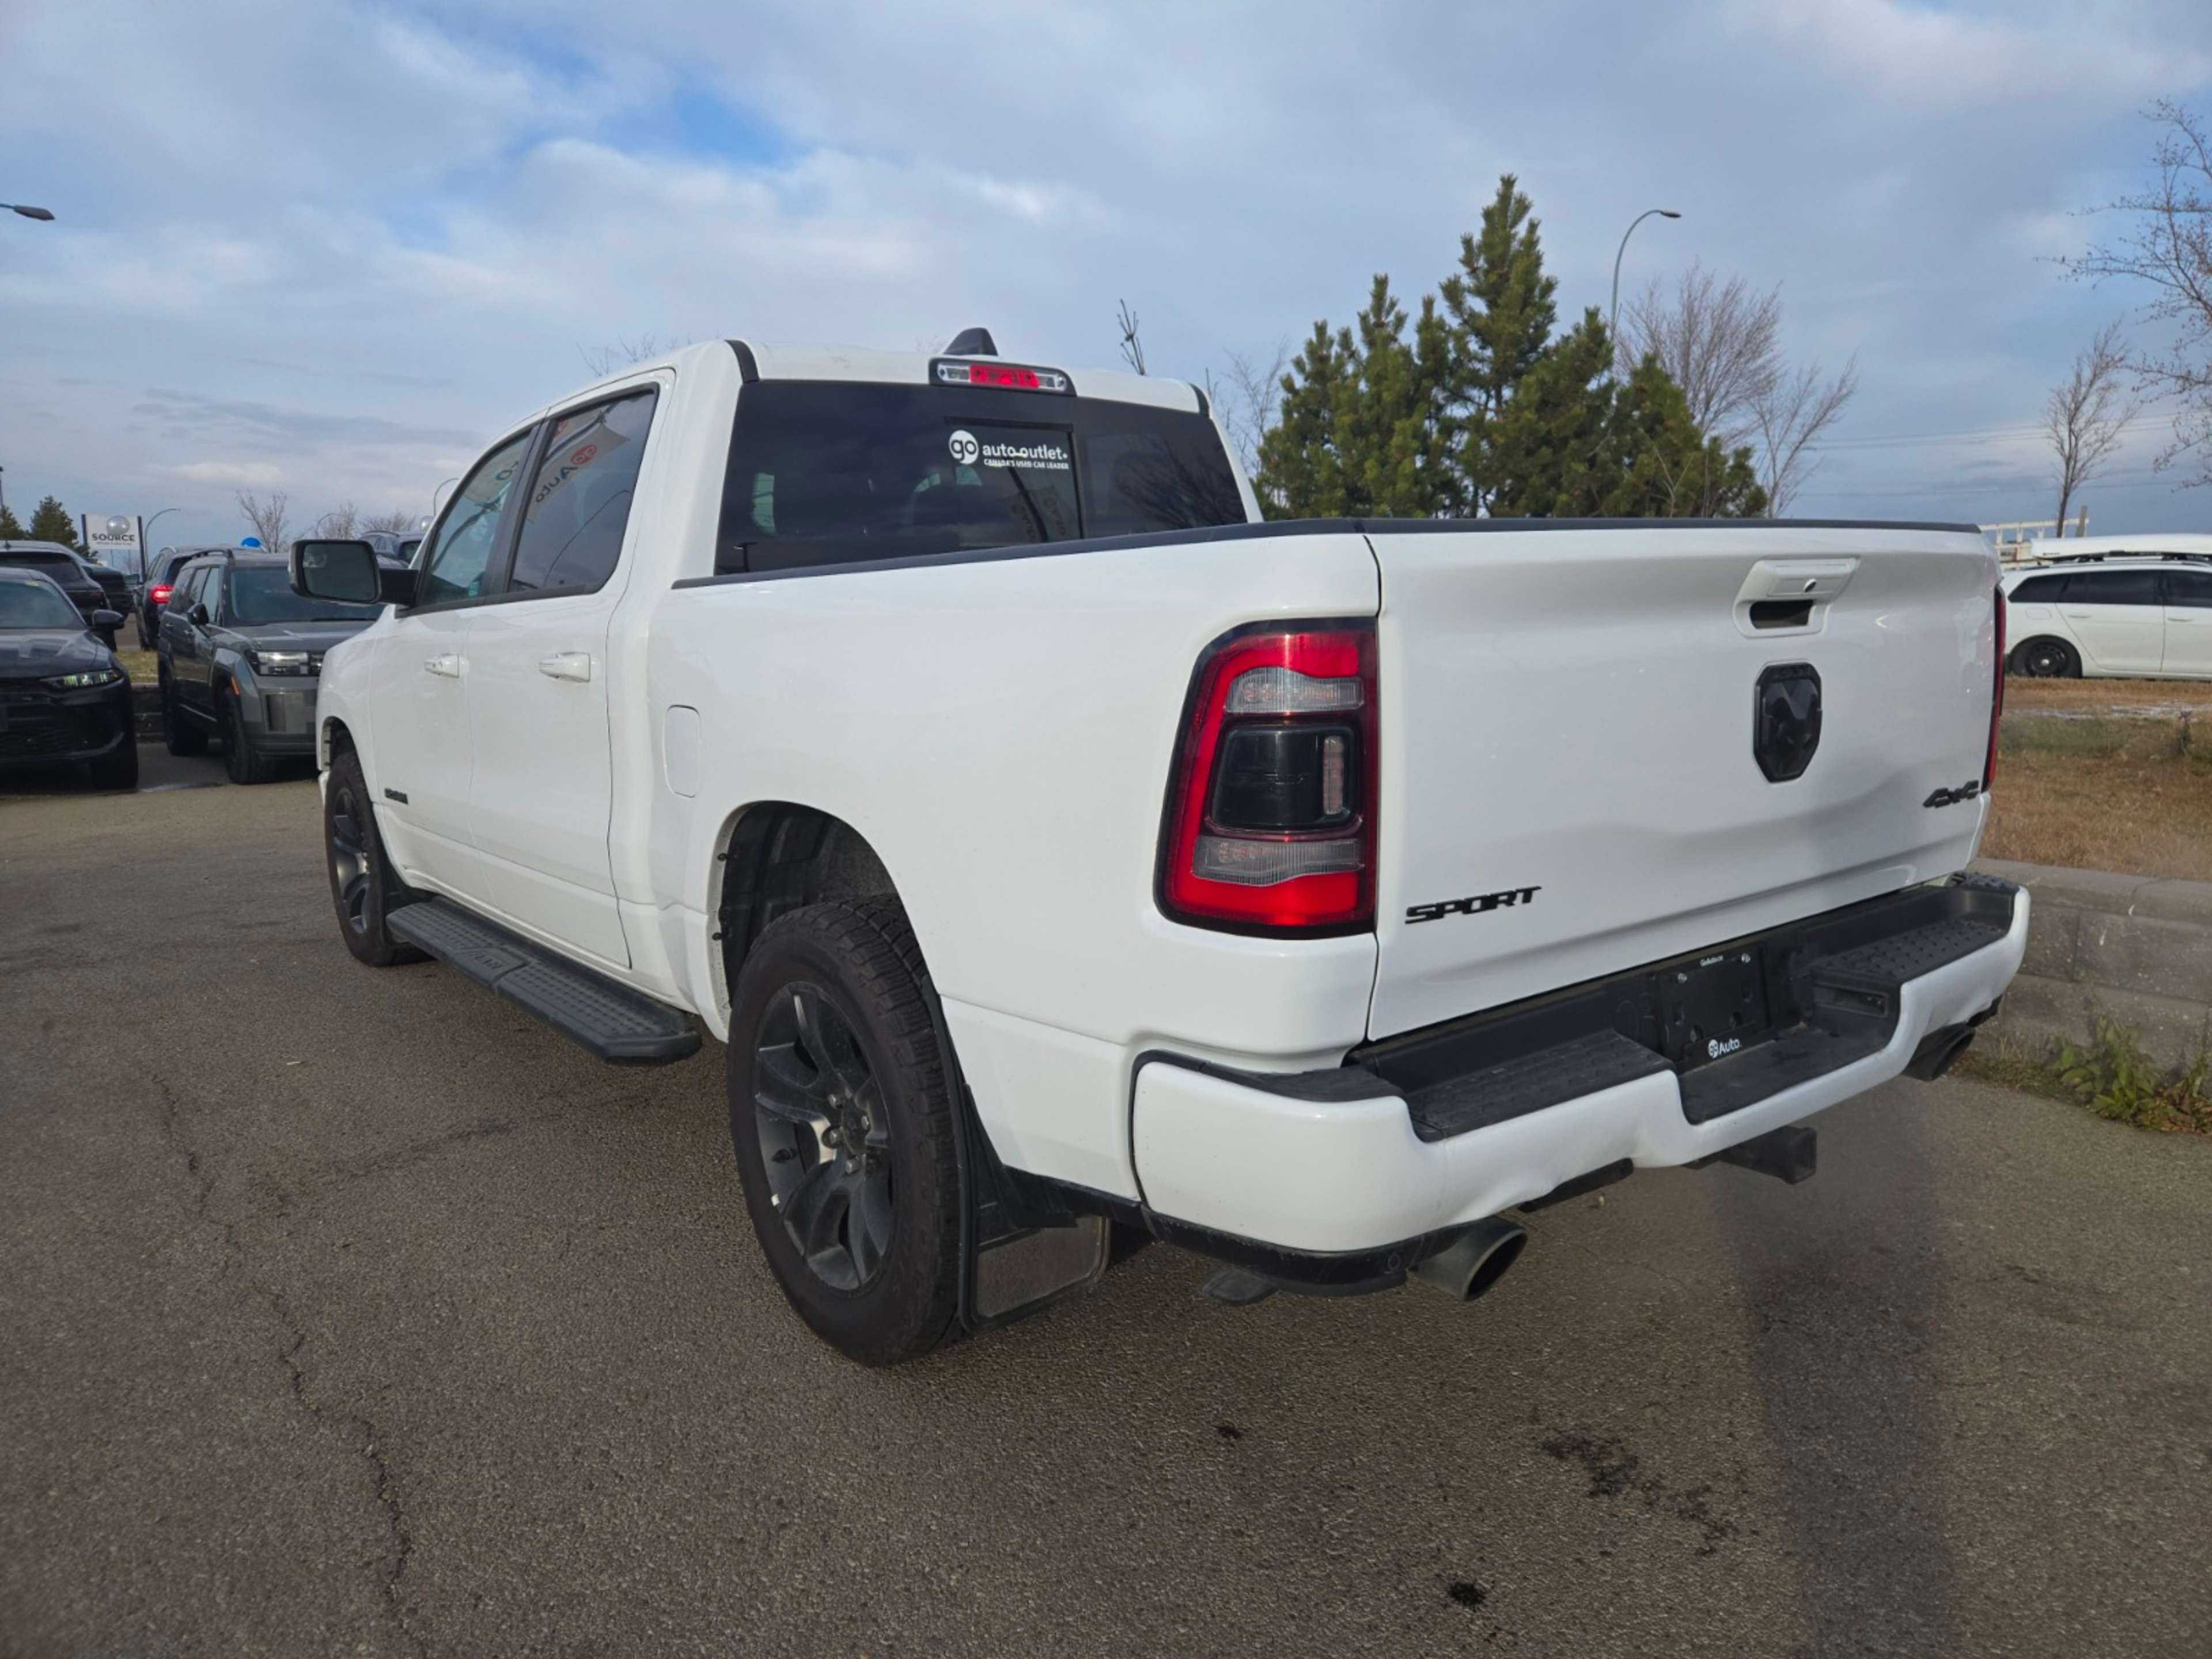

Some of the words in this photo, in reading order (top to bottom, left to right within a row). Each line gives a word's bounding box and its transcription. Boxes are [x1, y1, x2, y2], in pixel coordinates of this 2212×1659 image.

[982, 444, 1016, 457] auto
[92, 533, 135, 542] SOURCE
[1404, 886, 1543, 924] SPORT
